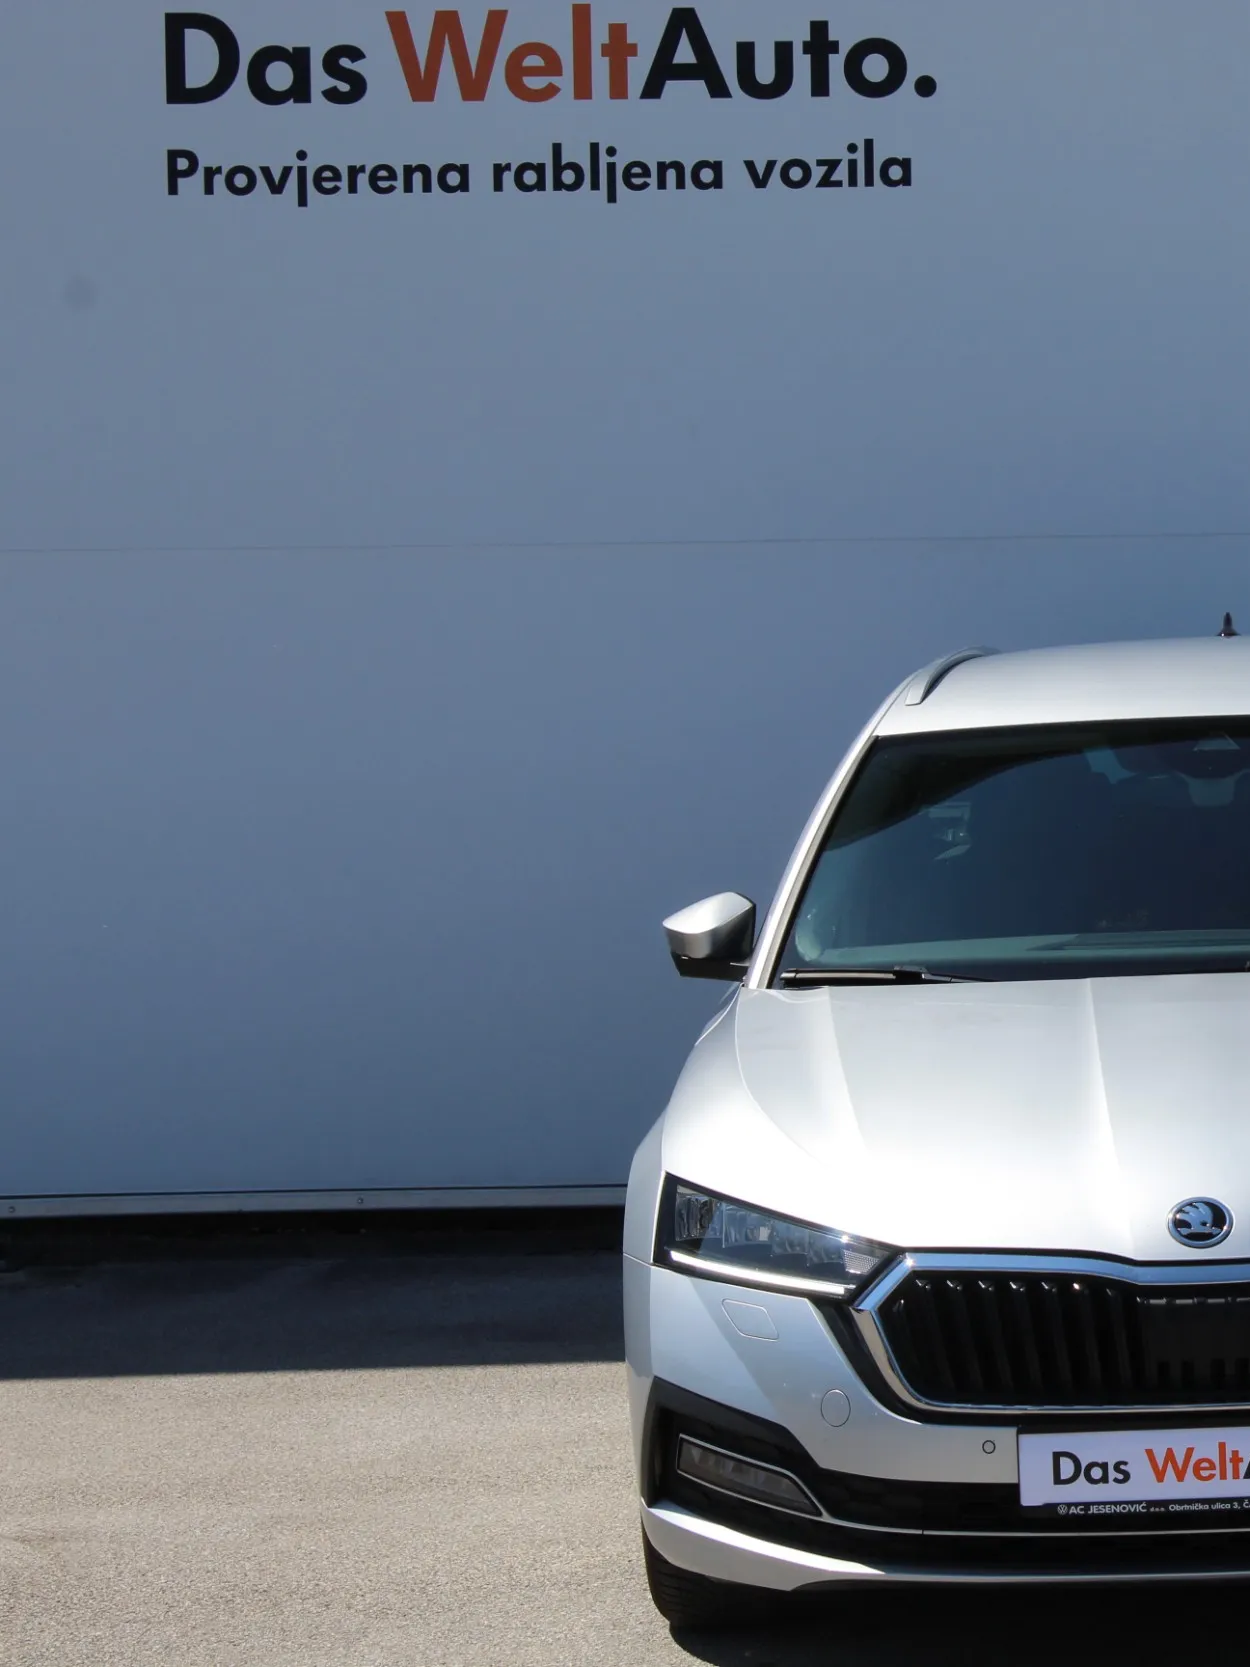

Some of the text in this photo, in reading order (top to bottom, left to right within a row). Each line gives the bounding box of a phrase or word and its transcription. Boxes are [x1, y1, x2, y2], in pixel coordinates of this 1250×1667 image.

[165, 4, 938, 105] Das WeltAuto.
[167, 138, 912, 208] Provjerena rabljena vozila
[1052, 1450, 1131, 1486] Das
[1068, 1505, 1085, 1515] AC
[1087, 1501, 1147, 1514] JESENOVIĆ
[1168, 1502, 1209, 1512] Obrtnička
[1211, 1502, 1231, 1510] ulica
